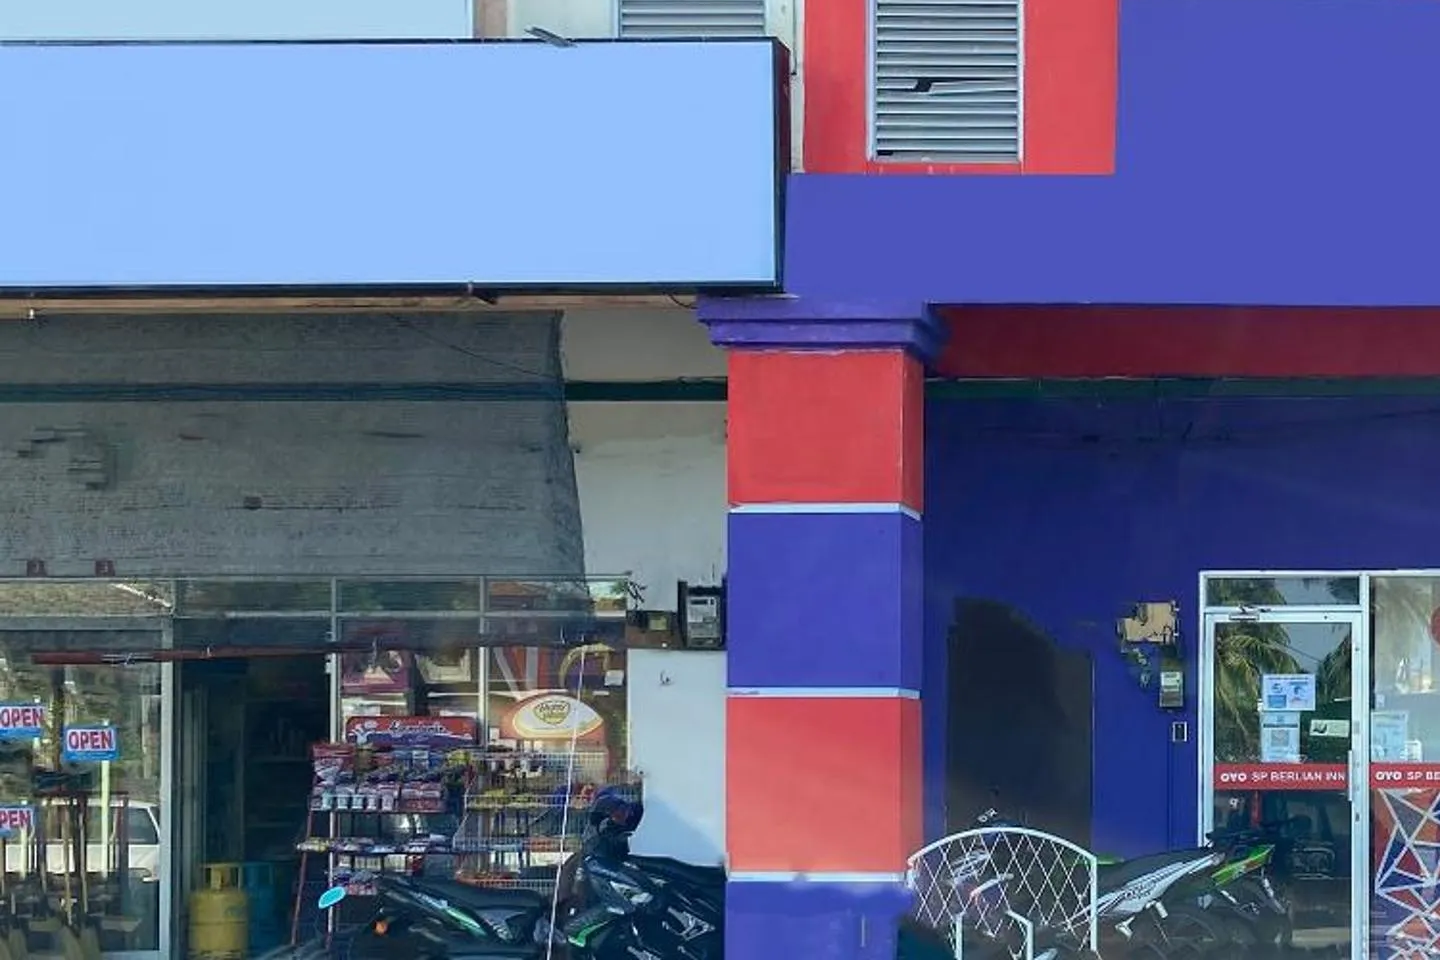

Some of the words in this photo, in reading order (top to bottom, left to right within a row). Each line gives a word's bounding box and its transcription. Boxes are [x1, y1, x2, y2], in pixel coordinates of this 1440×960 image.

[0, 708, 44, 727] OPEN
[68, 731, 114, 750] OPEN
[1220, 772, 1247, 783] OYO
[1376, 771, 1402, 781] OYO
[1406, 770, 1423, 781] SP
[0, 810, 31, 828] PEN
